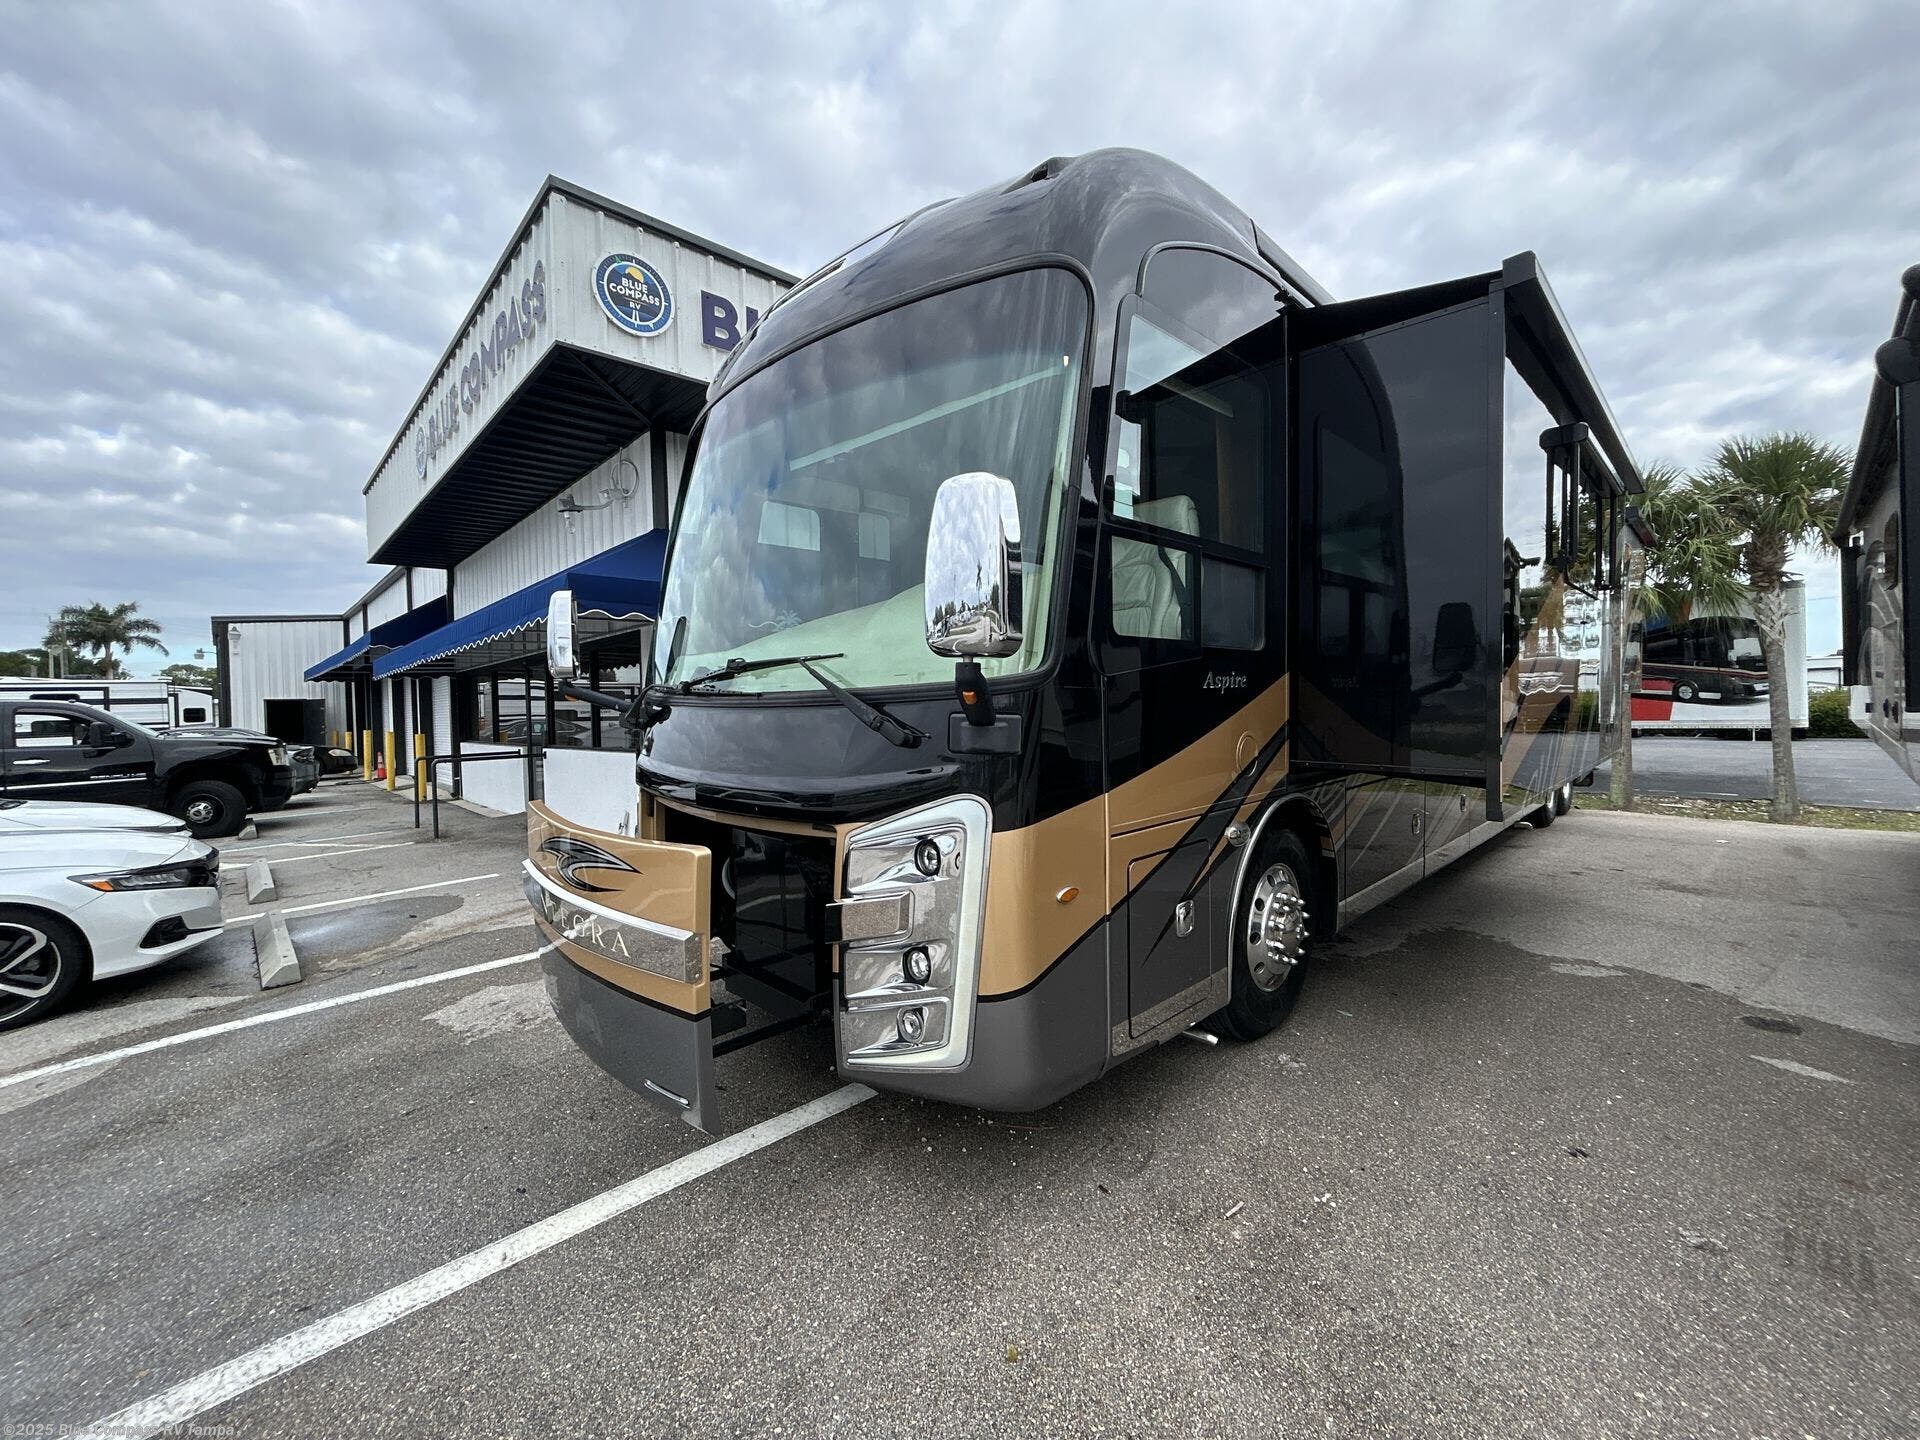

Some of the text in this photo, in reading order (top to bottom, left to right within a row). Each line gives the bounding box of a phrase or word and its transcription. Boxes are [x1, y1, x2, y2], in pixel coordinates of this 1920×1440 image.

[609, 282, 660, 306] COMPASS
[621, 276, 649, 294] BLUE
[629, 301, 642, 310] RV
[460, 259, 546, 416] COMPASS
[1202, 670, 1248, 695] Aspire
